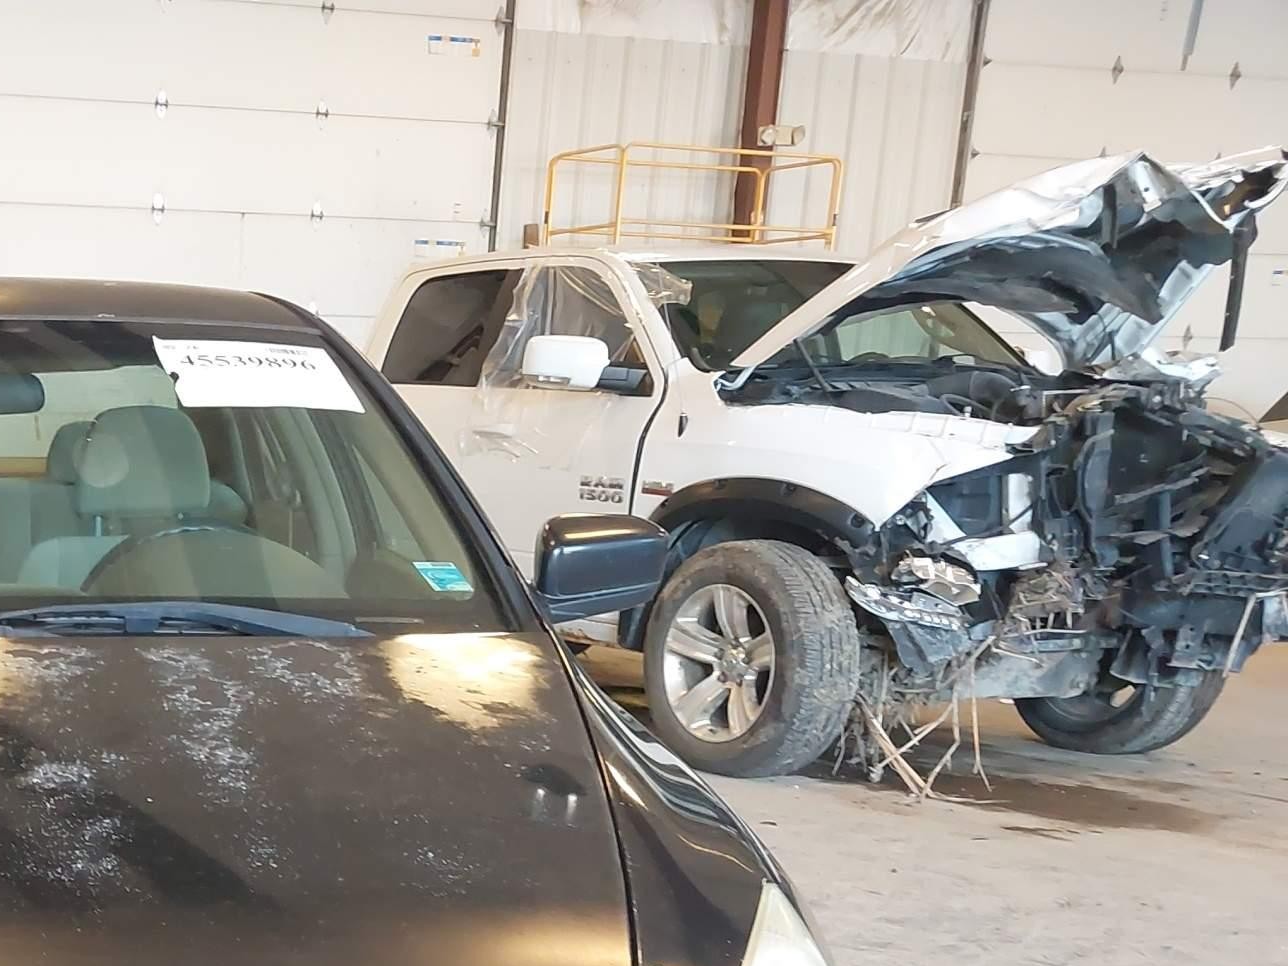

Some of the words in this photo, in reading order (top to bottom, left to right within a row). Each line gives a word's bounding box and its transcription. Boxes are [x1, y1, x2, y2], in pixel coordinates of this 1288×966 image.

[180, 354, 317, 371] 45539896
[579, 475, 624, 490] RAM
[579, 488, 624, 504] 1500
